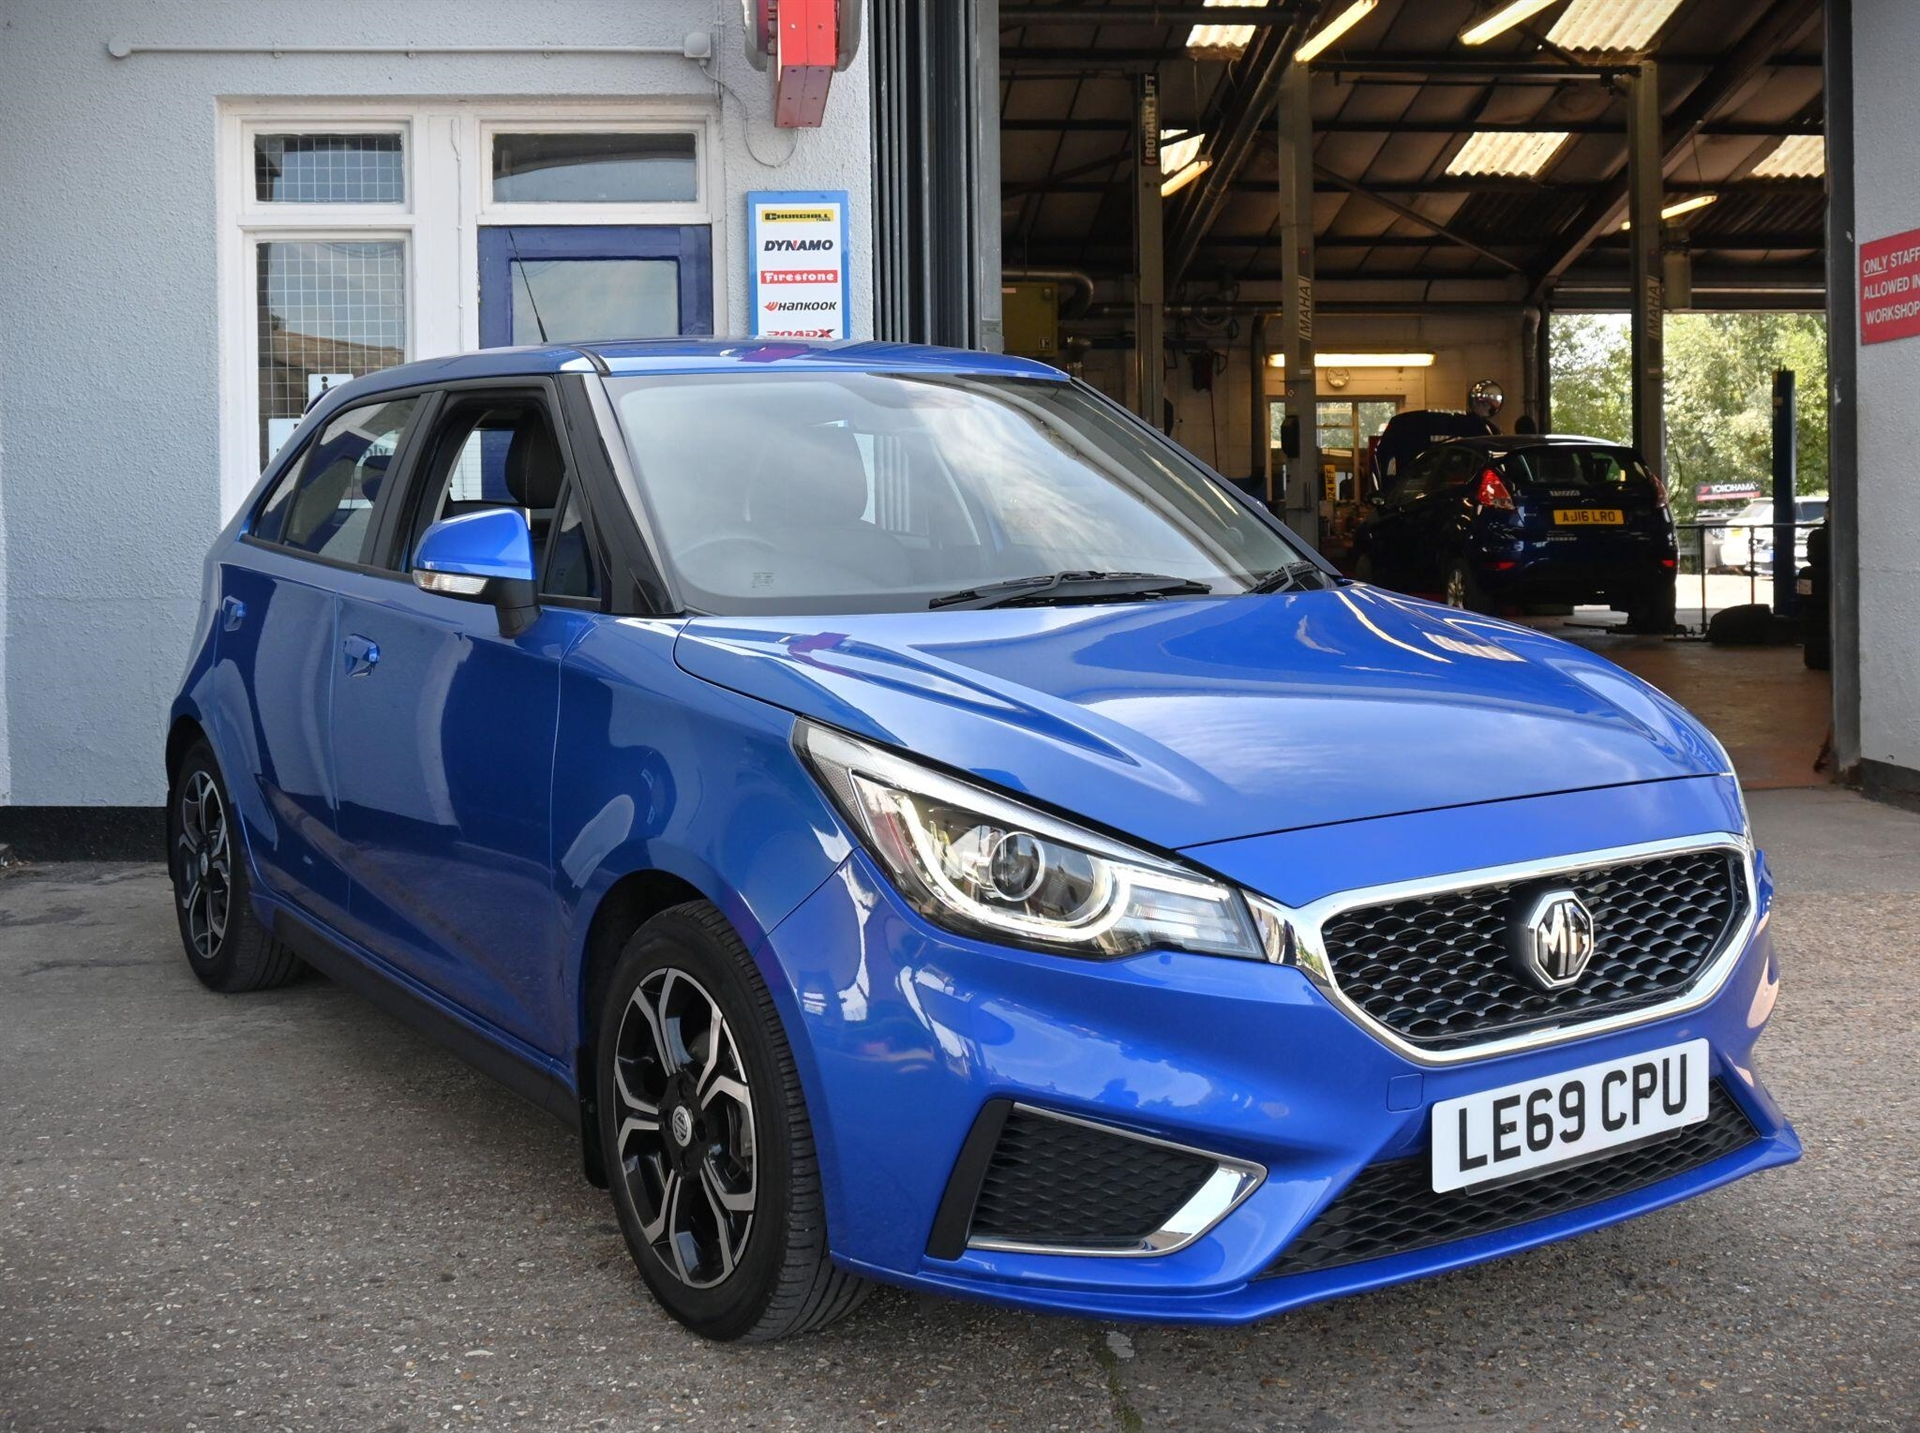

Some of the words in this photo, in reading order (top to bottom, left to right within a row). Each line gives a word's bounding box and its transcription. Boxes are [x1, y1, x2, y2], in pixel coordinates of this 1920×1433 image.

[1144, 74, 1156, 101] LIFT
[1144, 105, 1156, 158] ROTARY
[764, 240, 834, 251] DYNAMO
[1863, 255, 1888, 275] ONLY
[1890, 246, 1920, 268] STAFF
[764, 272, 835, 283] Firestone
[1863, 277, 1910, 300] ALLOWED
[1299, 286, 1311, 334] MAHA
[1648, 286, 1660, 332] MAHA
[1865, 300, 1920, 325] WORKSHOP
[1711, 483, 1756, 493] YOKOHAMA
[1562, 510, 1590, 522] AJ16
[1591, 510, 1616, 522] LRO
[1538, 900, 1590, 978] MG
[1458, 1079, 1586, 1173] LE69
[1601, 1053, 1688, 1133] CPU
